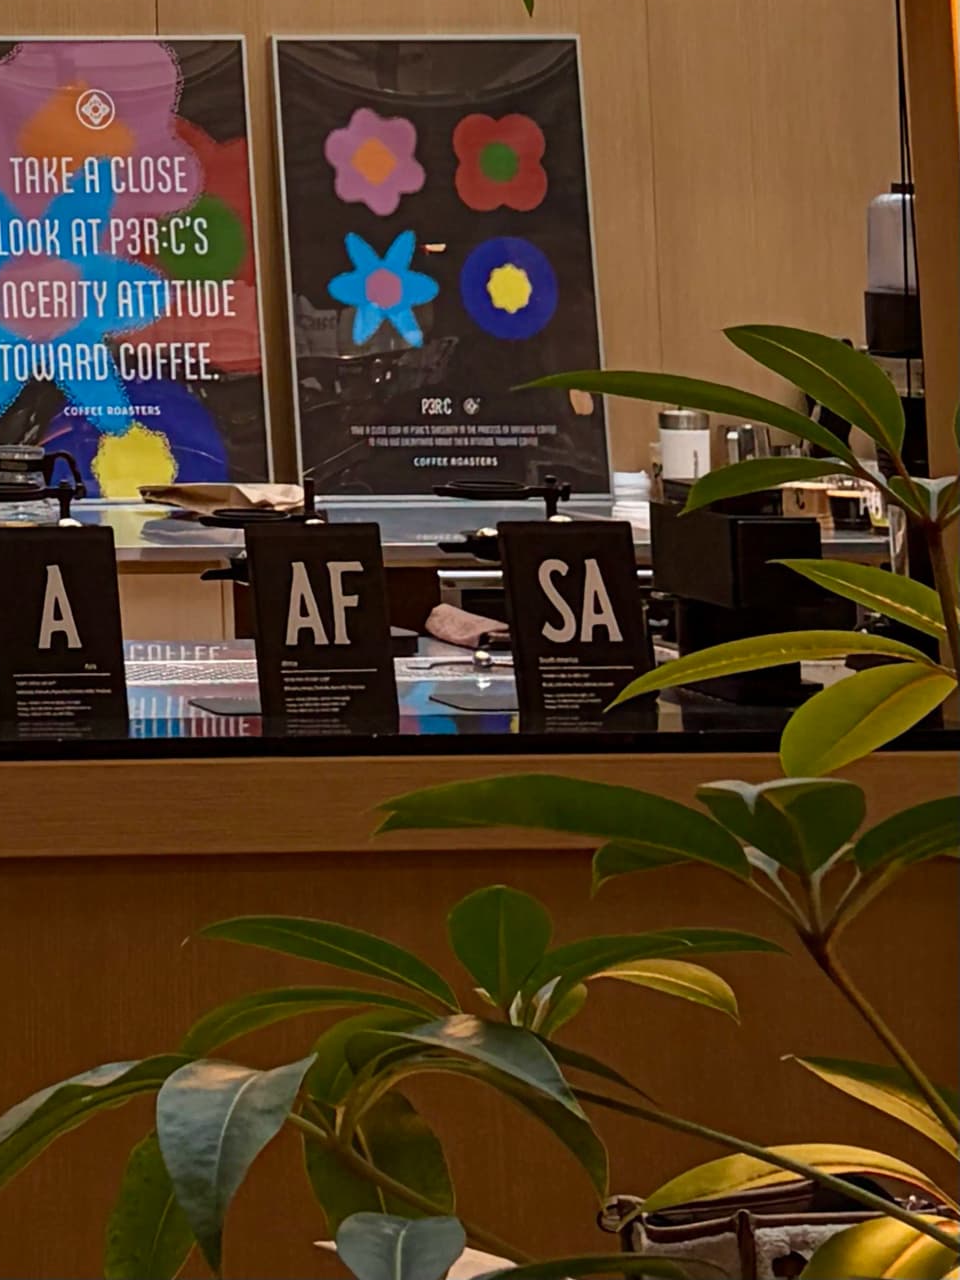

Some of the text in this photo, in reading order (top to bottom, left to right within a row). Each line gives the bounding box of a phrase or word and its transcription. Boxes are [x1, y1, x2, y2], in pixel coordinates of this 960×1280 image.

[9, 156, 188, 194] TAKE A CLOSE
[71, 218, 101, 256] AT
[118, 279, 236, 318] ATTITUDE
[0, 342, 220, 382] TOWARD COFFEE.
[38, 564, 82, 649] A
[285, 561, 364, 645] AF
[538, 558, 623, 643] SA
